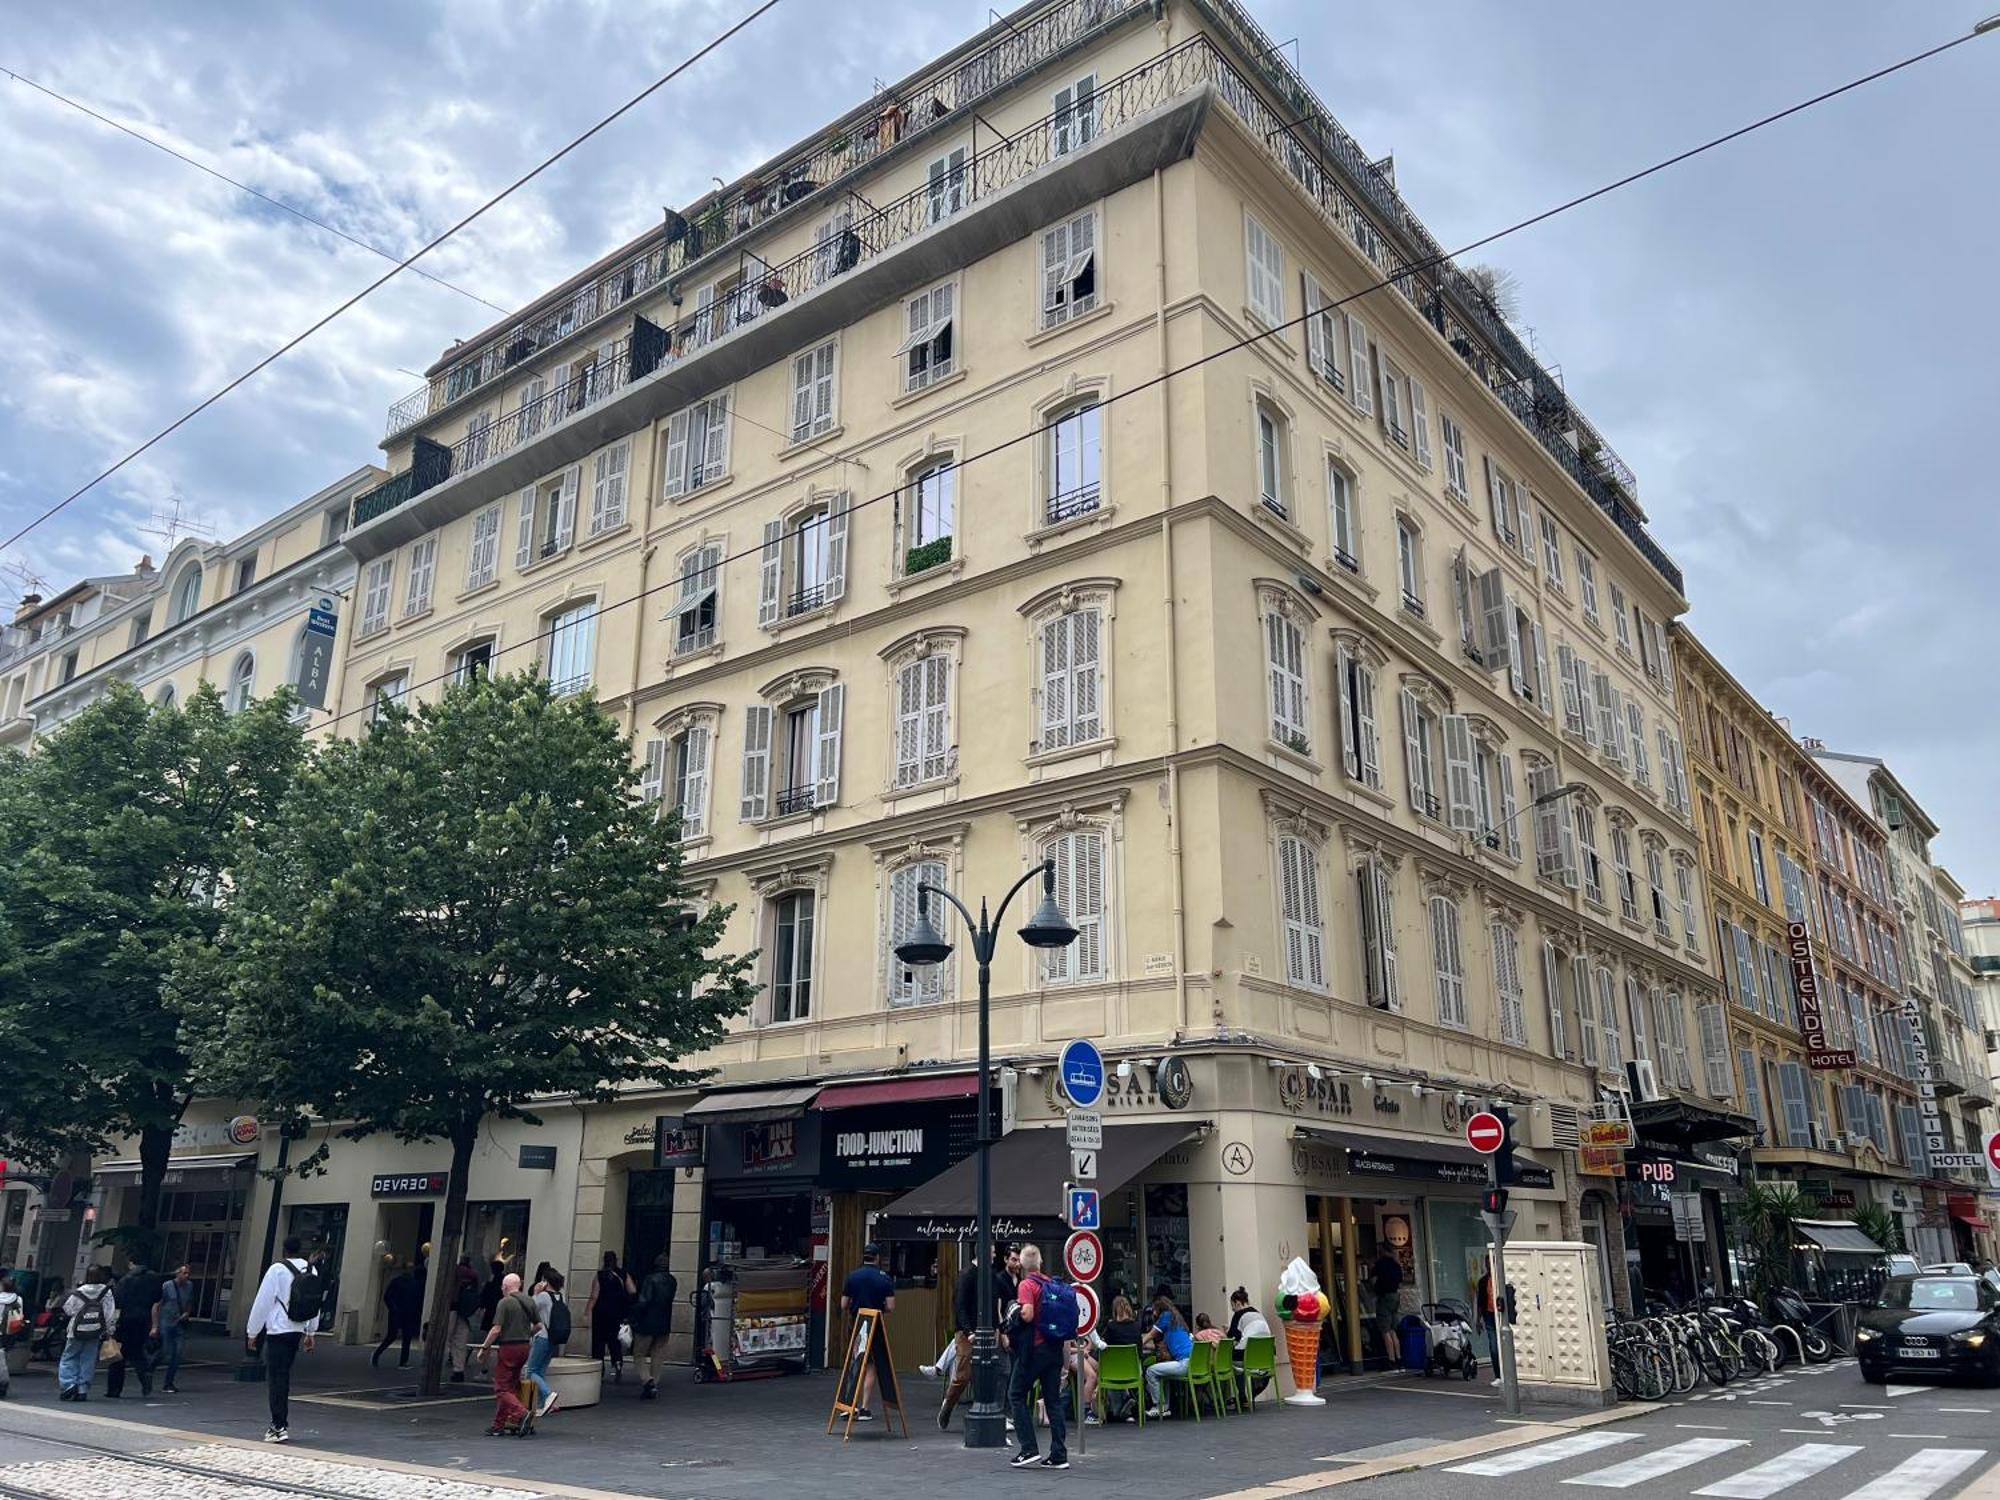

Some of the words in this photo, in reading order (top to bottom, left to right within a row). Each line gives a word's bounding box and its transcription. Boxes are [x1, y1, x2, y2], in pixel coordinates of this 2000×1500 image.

[308, 645, 322, 690] ALBA
[1789, 923, 1823, 1049] OSTENDE
[1811, 1054, 1854, 1066] HOTEL
[1905, 1000, 1941, 1149] AMARYLLIS
[836, 1128, 923, 1157] FOOD-JUNCTION
[1641, 1163, 1675, 1181] PUB
[1933, 1155, 1981, 1166] HOTEL
